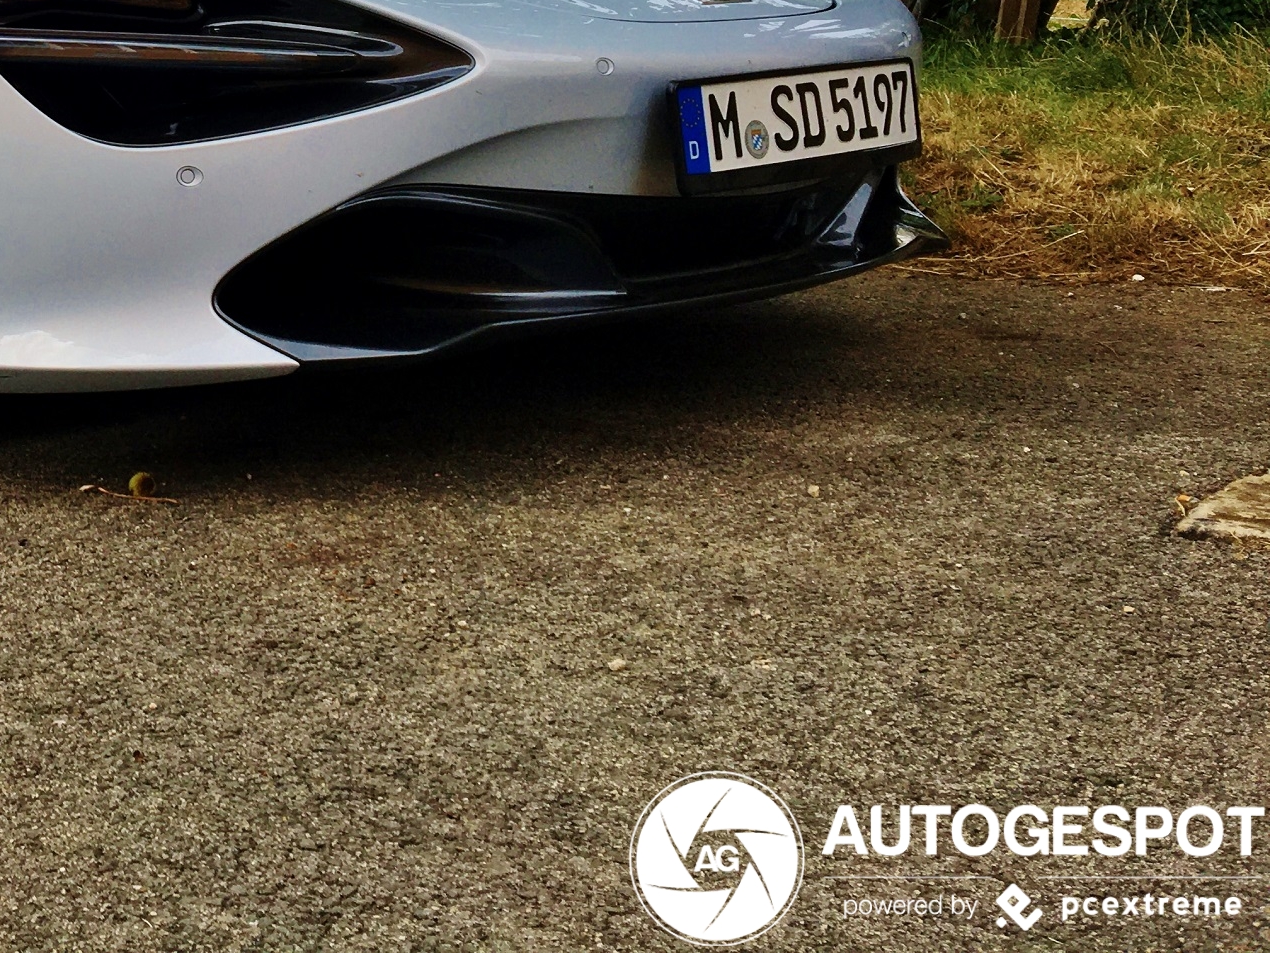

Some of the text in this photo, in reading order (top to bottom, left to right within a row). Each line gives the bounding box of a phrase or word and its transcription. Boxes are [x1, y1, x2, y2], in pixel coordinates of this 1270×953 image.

[708, 70, 908, 161] M SD 5197
[689, 140, 700, 160] D
